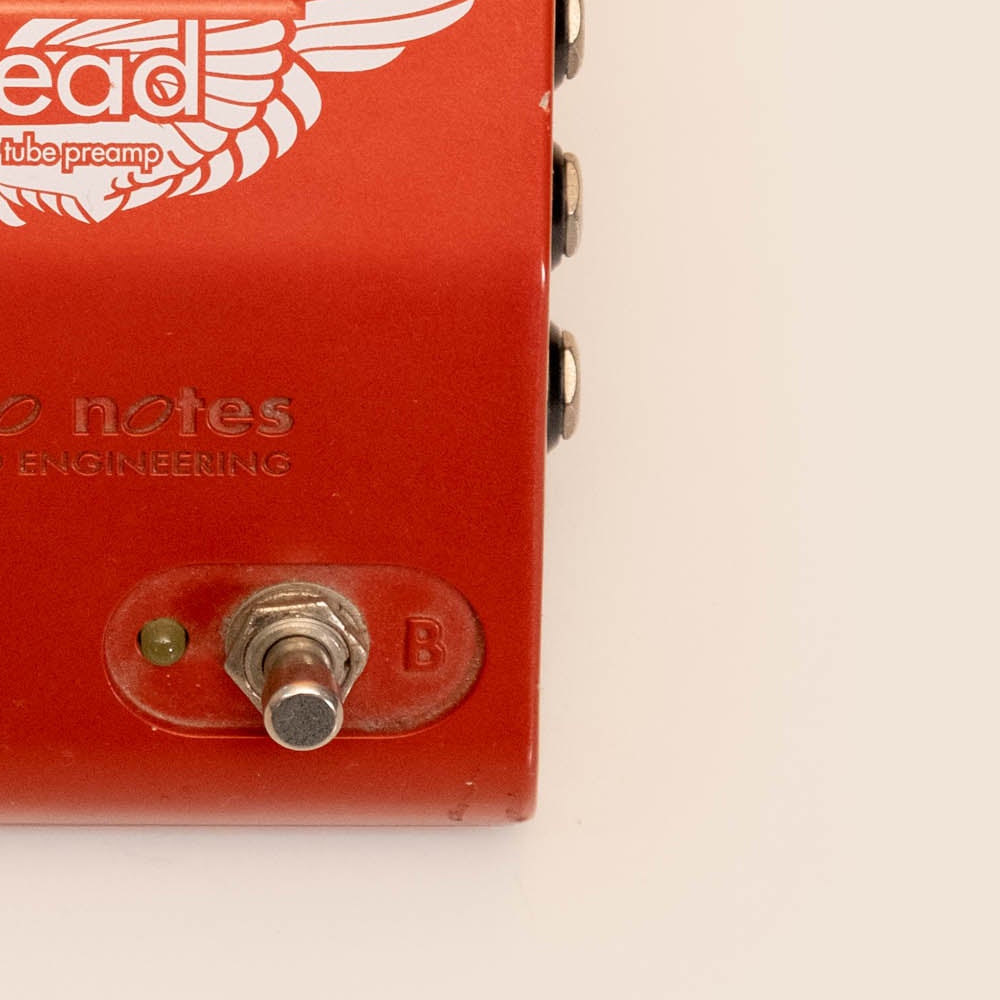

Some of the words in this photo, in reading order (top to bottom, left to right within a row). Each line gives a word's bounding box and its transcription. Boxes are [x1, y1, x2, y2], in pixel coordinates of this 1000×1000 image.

[3, 132, 63, 164] tube
[65, 141, 160, 170] preamp
[72, 386, 295, 438] notes
[19, 450, 292, 476] ENGINEERING
[404, 616, 446, 672] B
